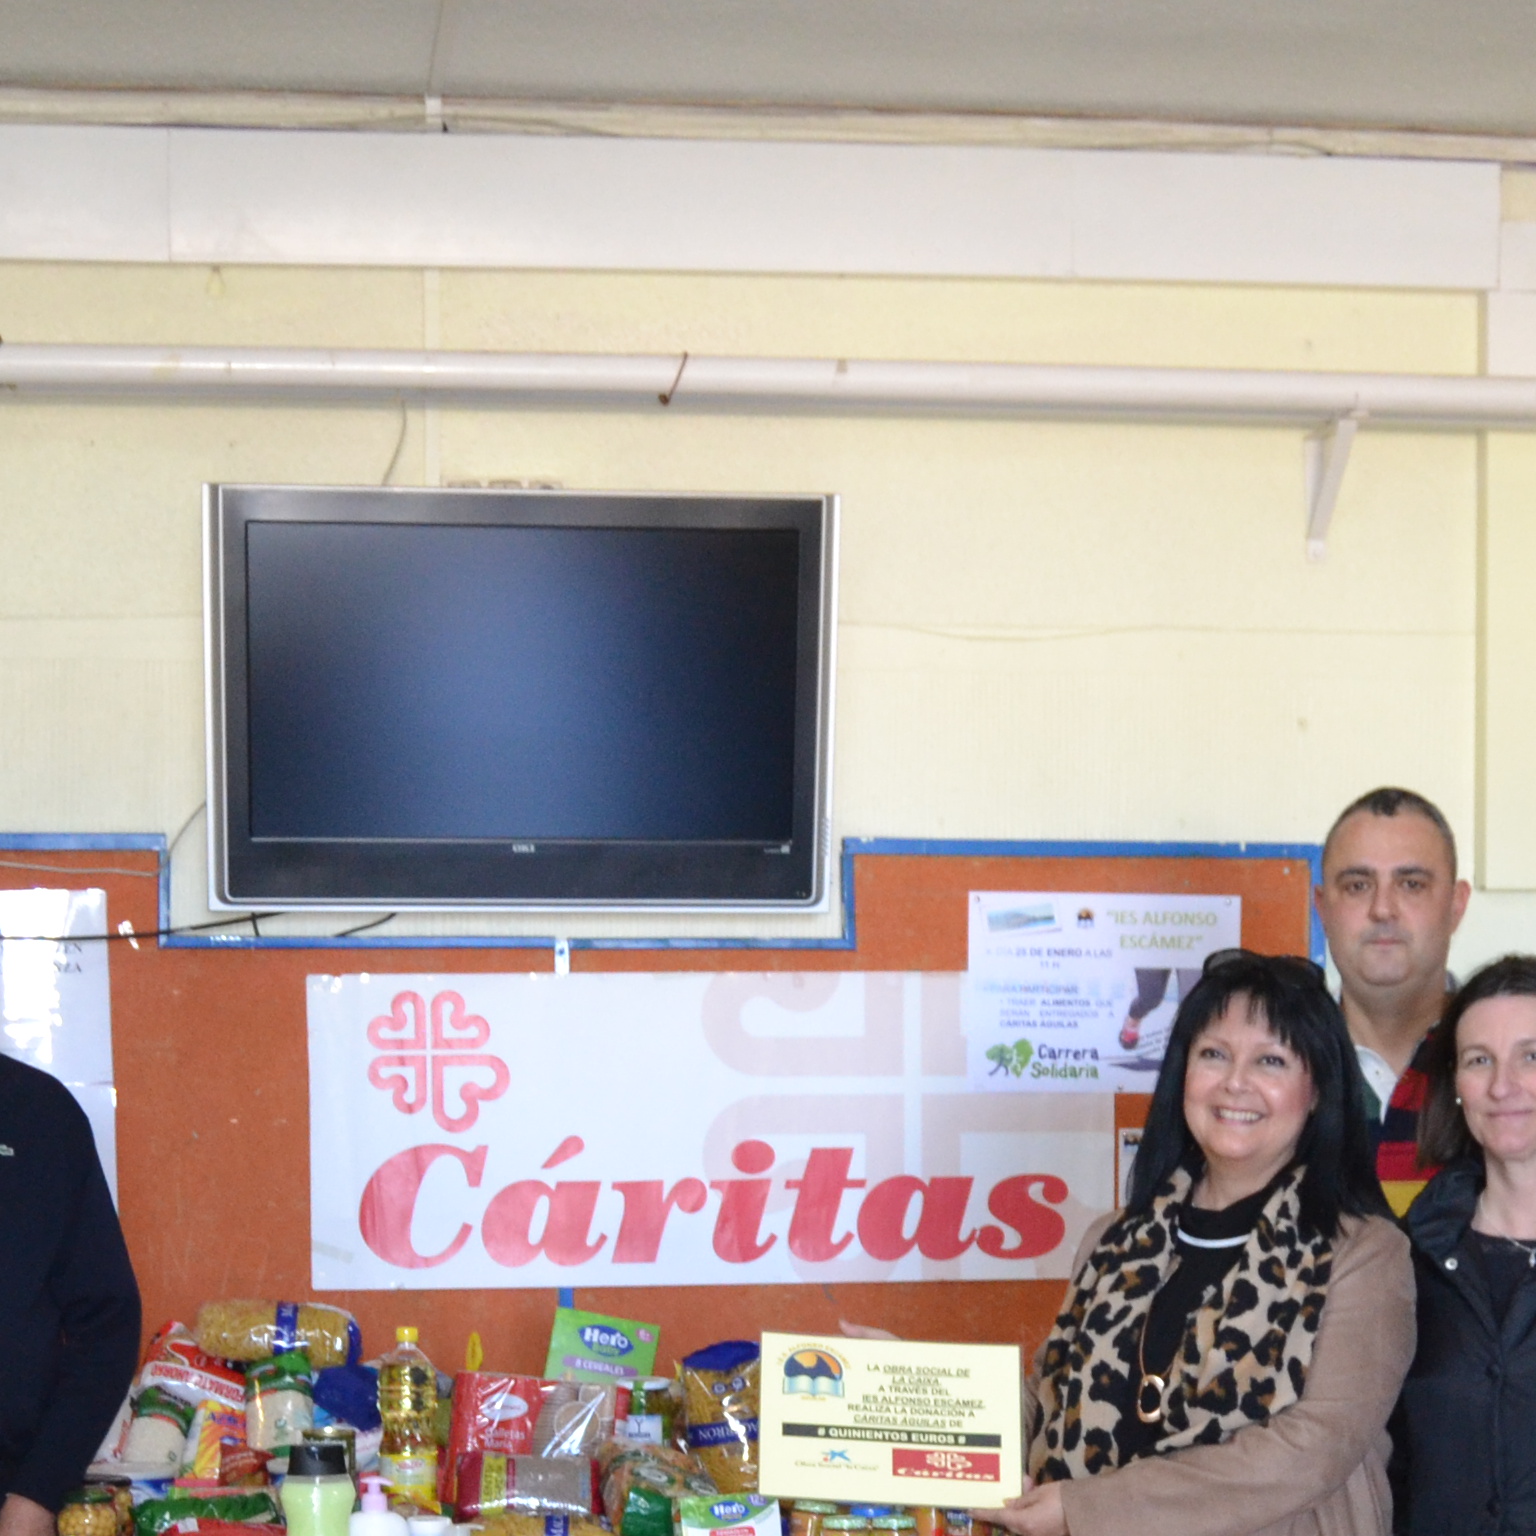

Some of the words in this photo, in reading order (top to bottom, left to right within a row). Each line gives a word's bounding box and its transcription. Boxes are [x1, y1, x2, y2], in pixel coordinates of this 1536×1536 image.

[1143, 911, 1217, 927] ALFONSO
[1029, 948, 1044, 958] DE
[1047, 948, 1083, 959] ENERO
[1041, 999, 1091, 1008] ALIMENTOS
[1038, 1044, 1100, 1061] Carrera
[1031, 1062, 1099, 1080] Solidaria
[359, 1135, 1069, 1268] Cáritas
[584, 1327, 629, 1348] Hero
[583, 1361, 625, 1376] CEREALES
[866, 1364, 881, 1373] LA
[883, 1365, 913, 1375] OBRA
[915, 1366, 953, 1377] SOCIAL
[956, 1368, 971, 1378] DE
[892, 1376, 906, 1385] LA
[931, 1387, 950, 1396] DEL
[862, 1394, 880, 1404] IES
[881, 1395, 931, 1406] ALFONSO
[847, 1403, 892, 1414] REALIZA
[894, 1405, 909, 1415] LA
[949, 1419, 963, 1429] DE
[828, 1427, 909, 1442] QUINIENTOS
[911, 1432, 956, 1445] EUROS
[713, 1504, 745, 1517] Hero
